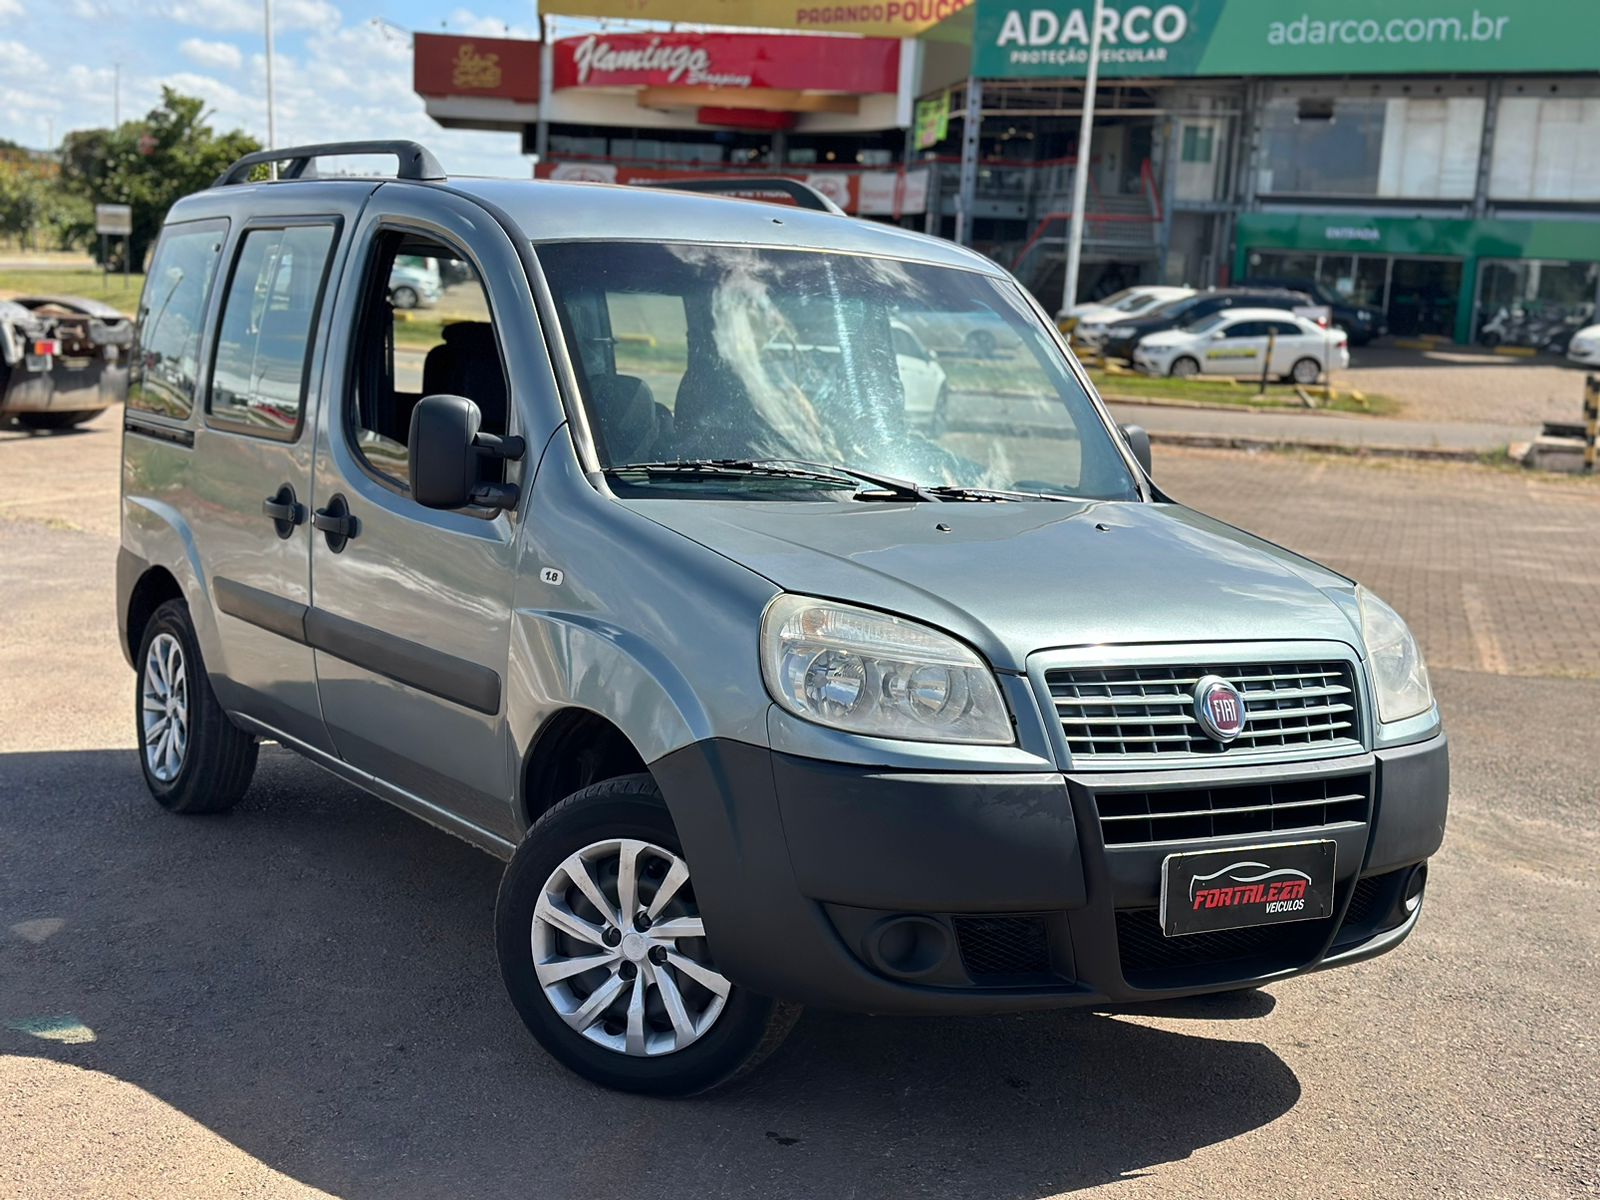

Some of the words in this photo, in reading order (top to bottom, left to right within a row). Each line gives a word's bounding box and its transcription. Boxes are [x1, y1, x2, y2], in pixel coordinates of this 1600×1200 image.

[796, 5, 884, 24] PAGANDO
[996, 4, 1187, 47] ADARCO
[1267, 9, 1509, 45] adarco.com.br
[573, 34, 711, 85] Flamingo
[1010, 47, 1088, 66] PROTEÇÃO
[545, 571, 559, 582] 1.8
[1213, 699, 1237, 722] FIAT
[1193, 880, 1307, 911] FORTALEZA
[1265, 898, 1306, 914] VEÍCULOS
